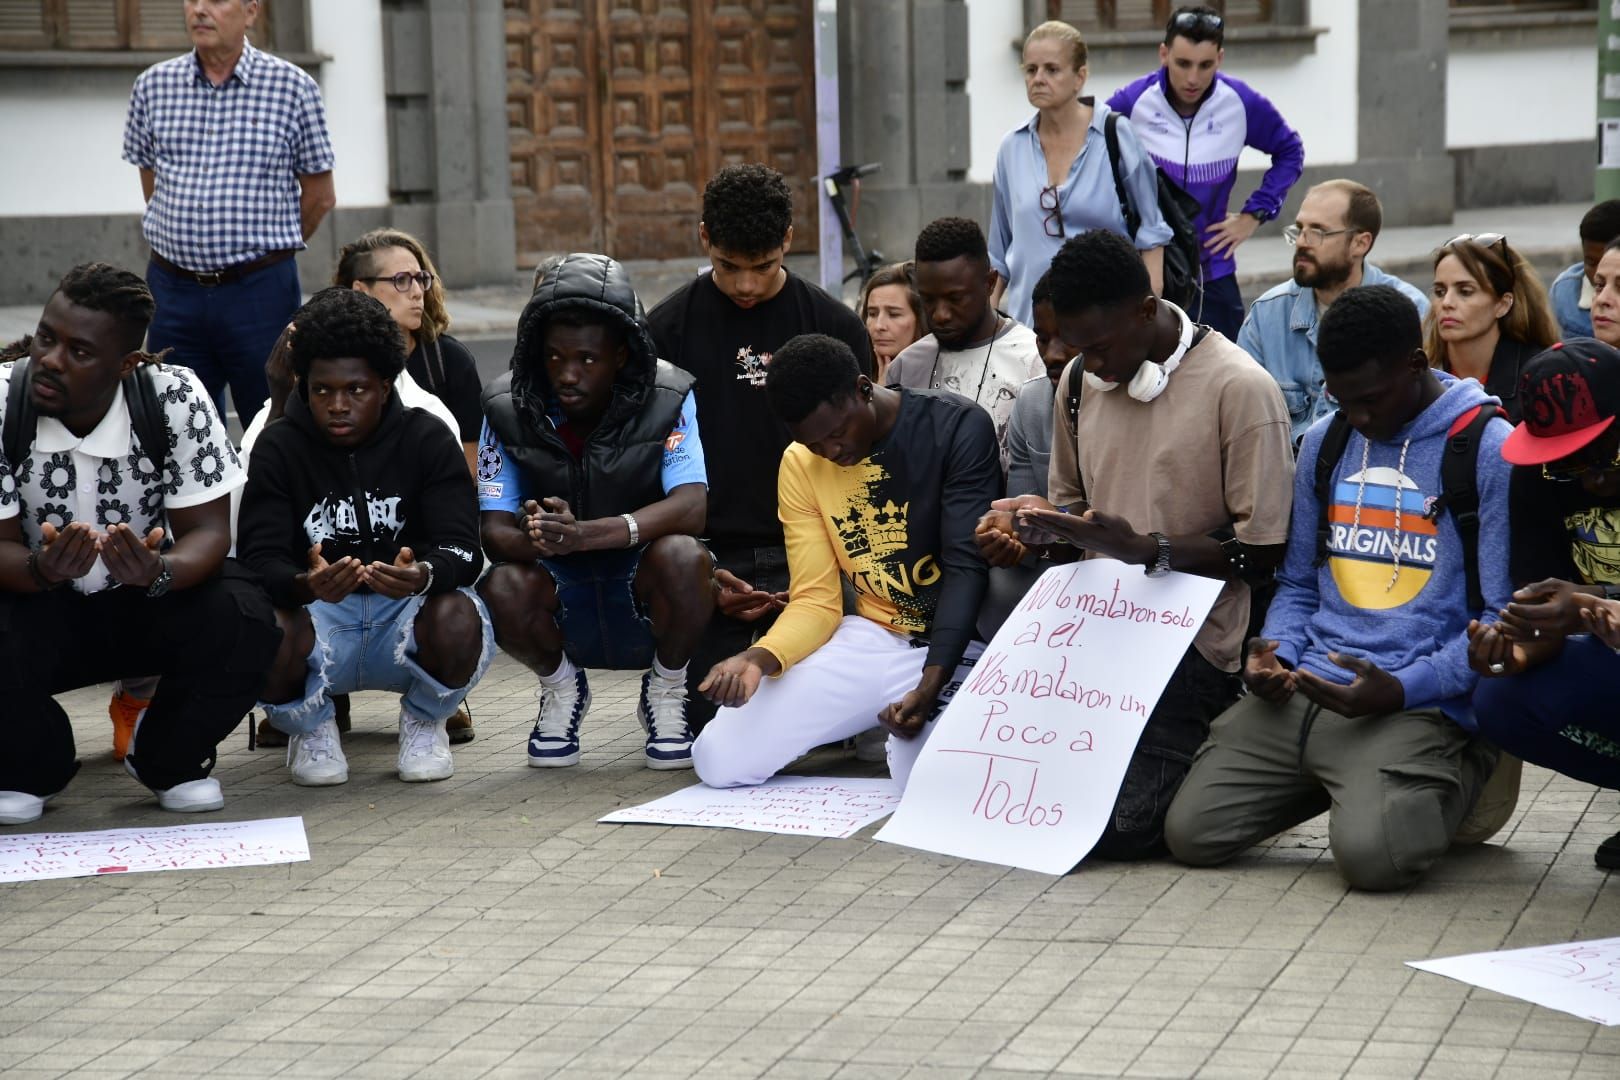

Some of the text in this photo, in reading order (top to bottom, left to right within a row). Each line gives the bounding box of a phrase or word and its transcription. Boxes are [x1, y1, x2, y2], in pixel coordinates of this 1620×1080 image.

[1075, 578, 1156, 623] mataron
[1160, 605, 1195, 628] solo
[1013, 621, 1041, 646] a
[965, 651, 1147, 717] Nos mataron un
[979, 699, 1093, 752] Poco a
